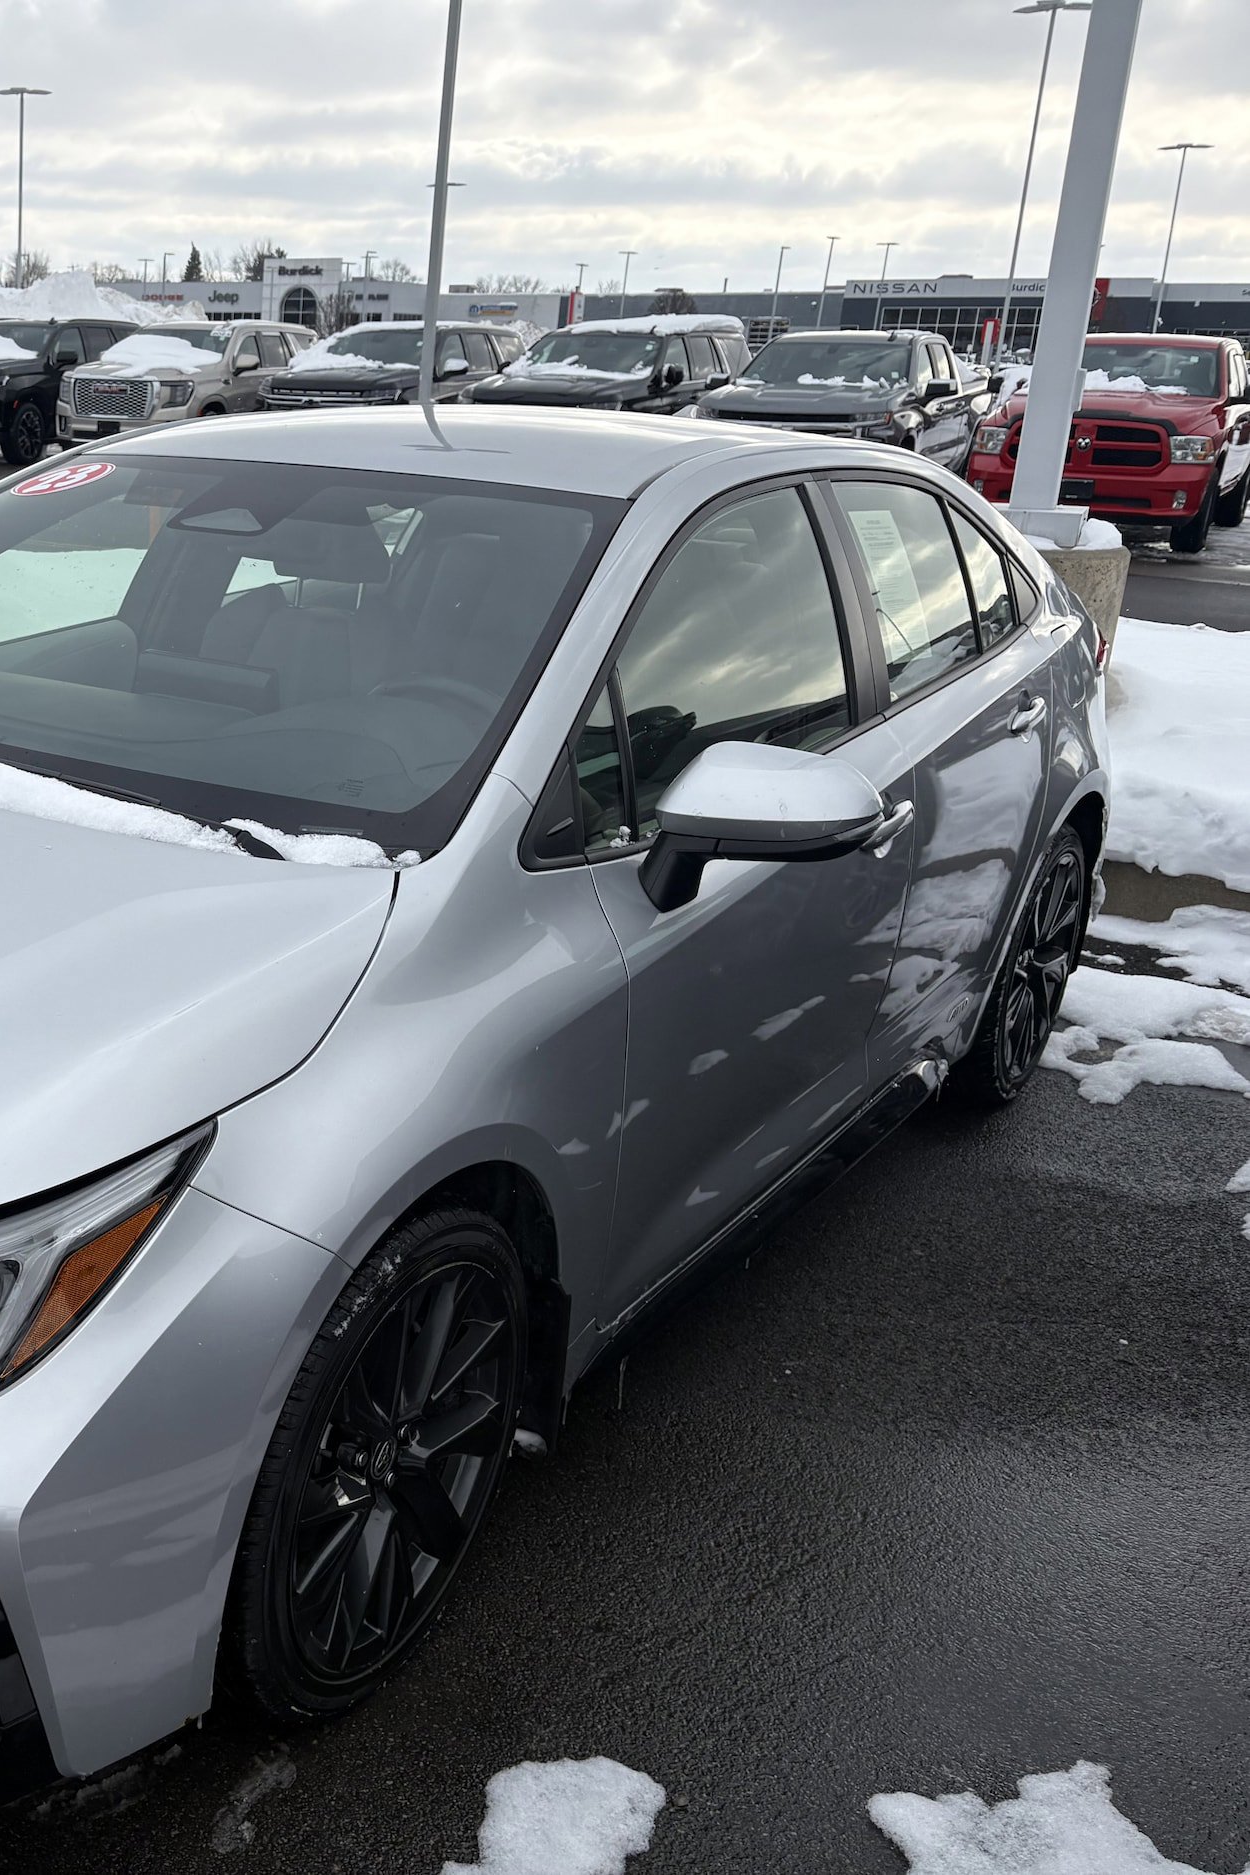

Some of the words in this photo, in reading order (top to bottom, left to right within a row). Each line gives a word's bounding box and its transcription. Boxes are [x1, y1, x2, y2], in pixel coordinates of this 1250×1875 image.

[278, 265, 323, 276] Burdick
[853, 283, 938, 295] NISSAN
[208, 290, 239, 305] Jeep
[21, 464, 102, 489] 23
